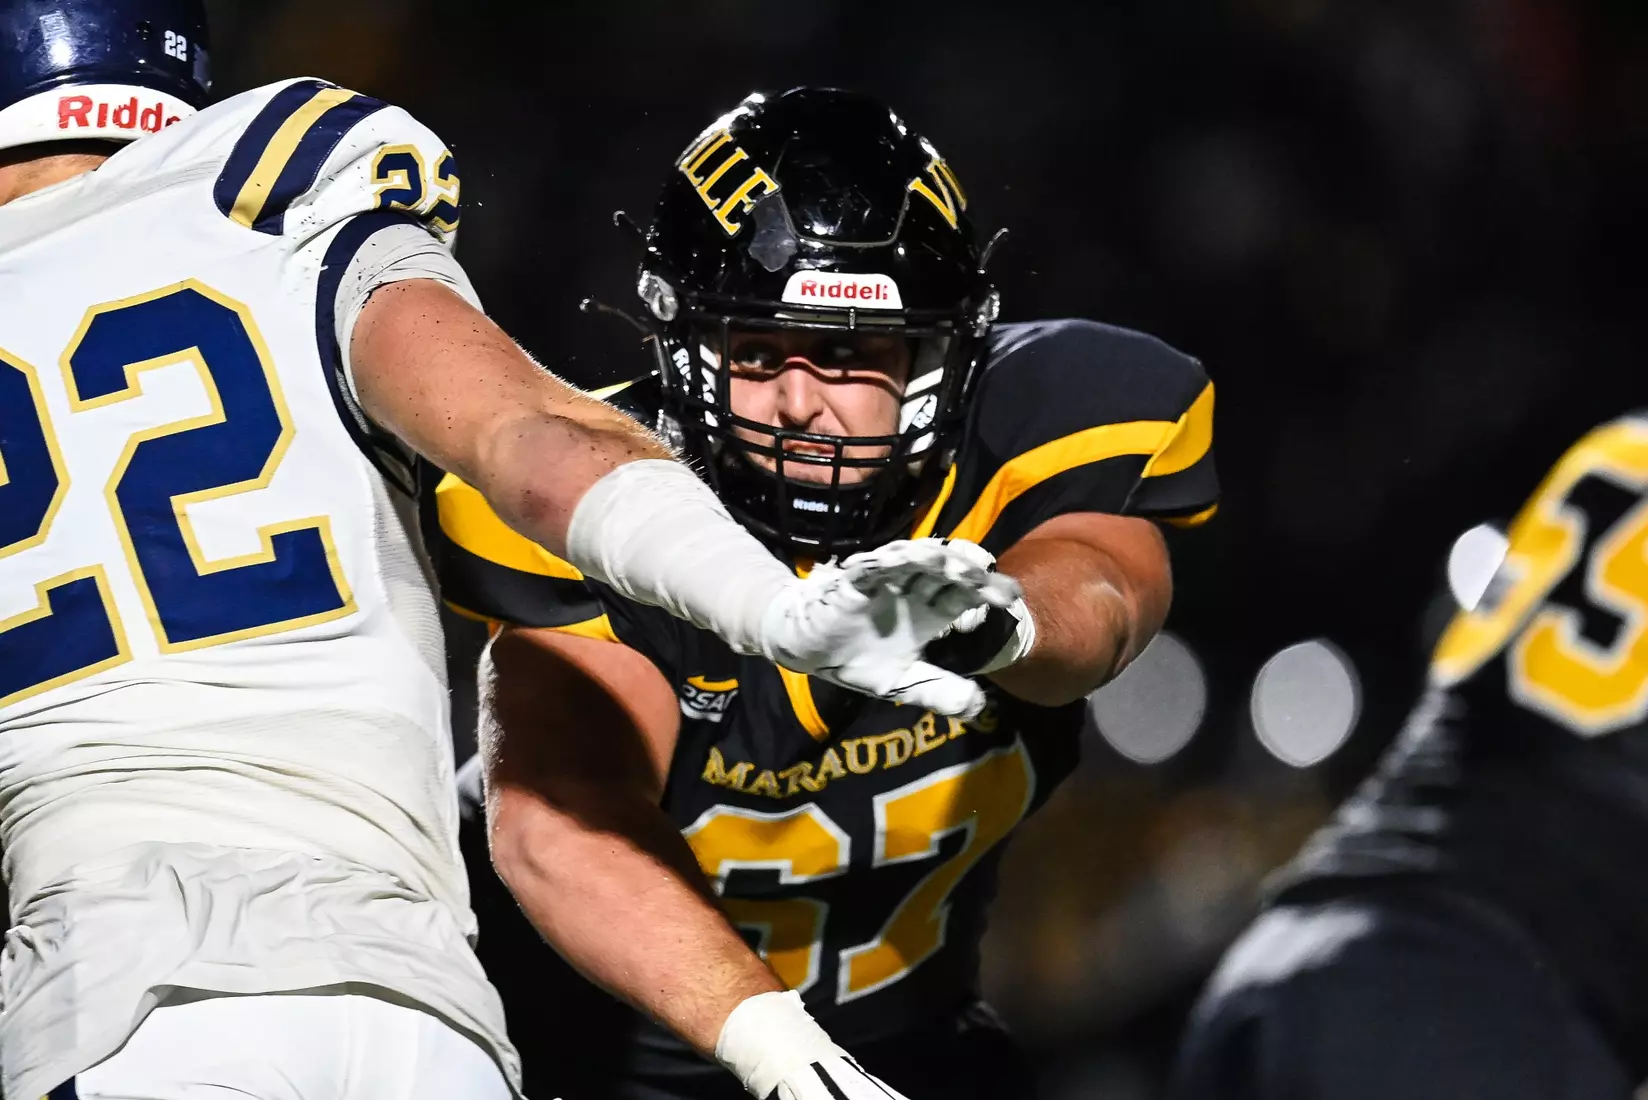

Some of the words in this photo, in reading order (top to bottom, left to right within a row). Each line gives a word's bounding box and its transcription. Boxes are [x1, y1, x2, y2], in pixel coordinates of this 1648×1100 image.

[164, 29, 188, 62] 22
[370, 143, 460, 234] 22
[681, 732, 1037, 1006] 67
